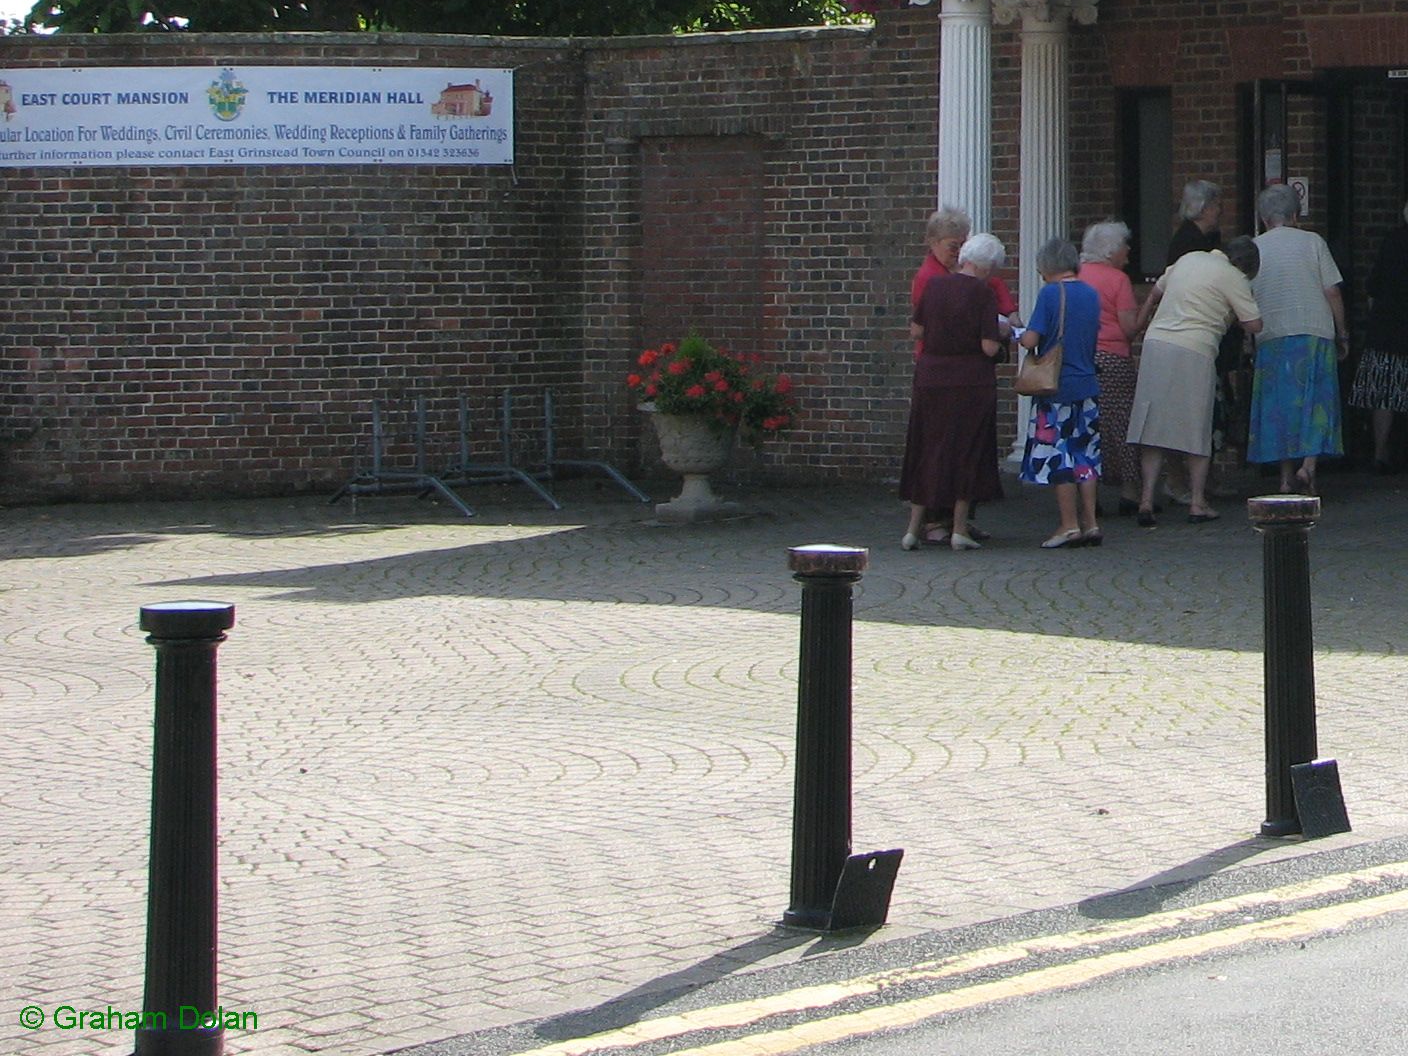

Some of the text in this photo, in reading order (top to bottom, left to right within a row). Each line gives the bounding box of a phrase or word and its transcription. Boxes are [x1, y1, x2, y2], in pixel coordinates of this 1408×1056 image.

[22, 92, 189, 106] EAST COURT MANSION
[267, 91, 424, 104] THE MERIDIAN HALL
[25, 126, 74, 142] Location
[78, 125, 98, 141] For
[164, 124, 192, 141] Civil
[274, 124, 327, 143] Wedding
[330, 124, 394, 143] Receptions
[397, 125, 406, 141] &
[409, 125, 447, 143] Family
[450, 124, 507, 143] Gatherings
[40, 149, 112, 160] information
[116, 148, 155, 161] please
[158, 147, 205, 159] contact
[209, 147, 235, 158] East
[238, 147, 298, 158] Grinstead
[302, 147, 335, 158] Town
[339, 147, 386, 158] Council
[389, 150, 404, 158] on
[407, 148, 440, 158] 01342
